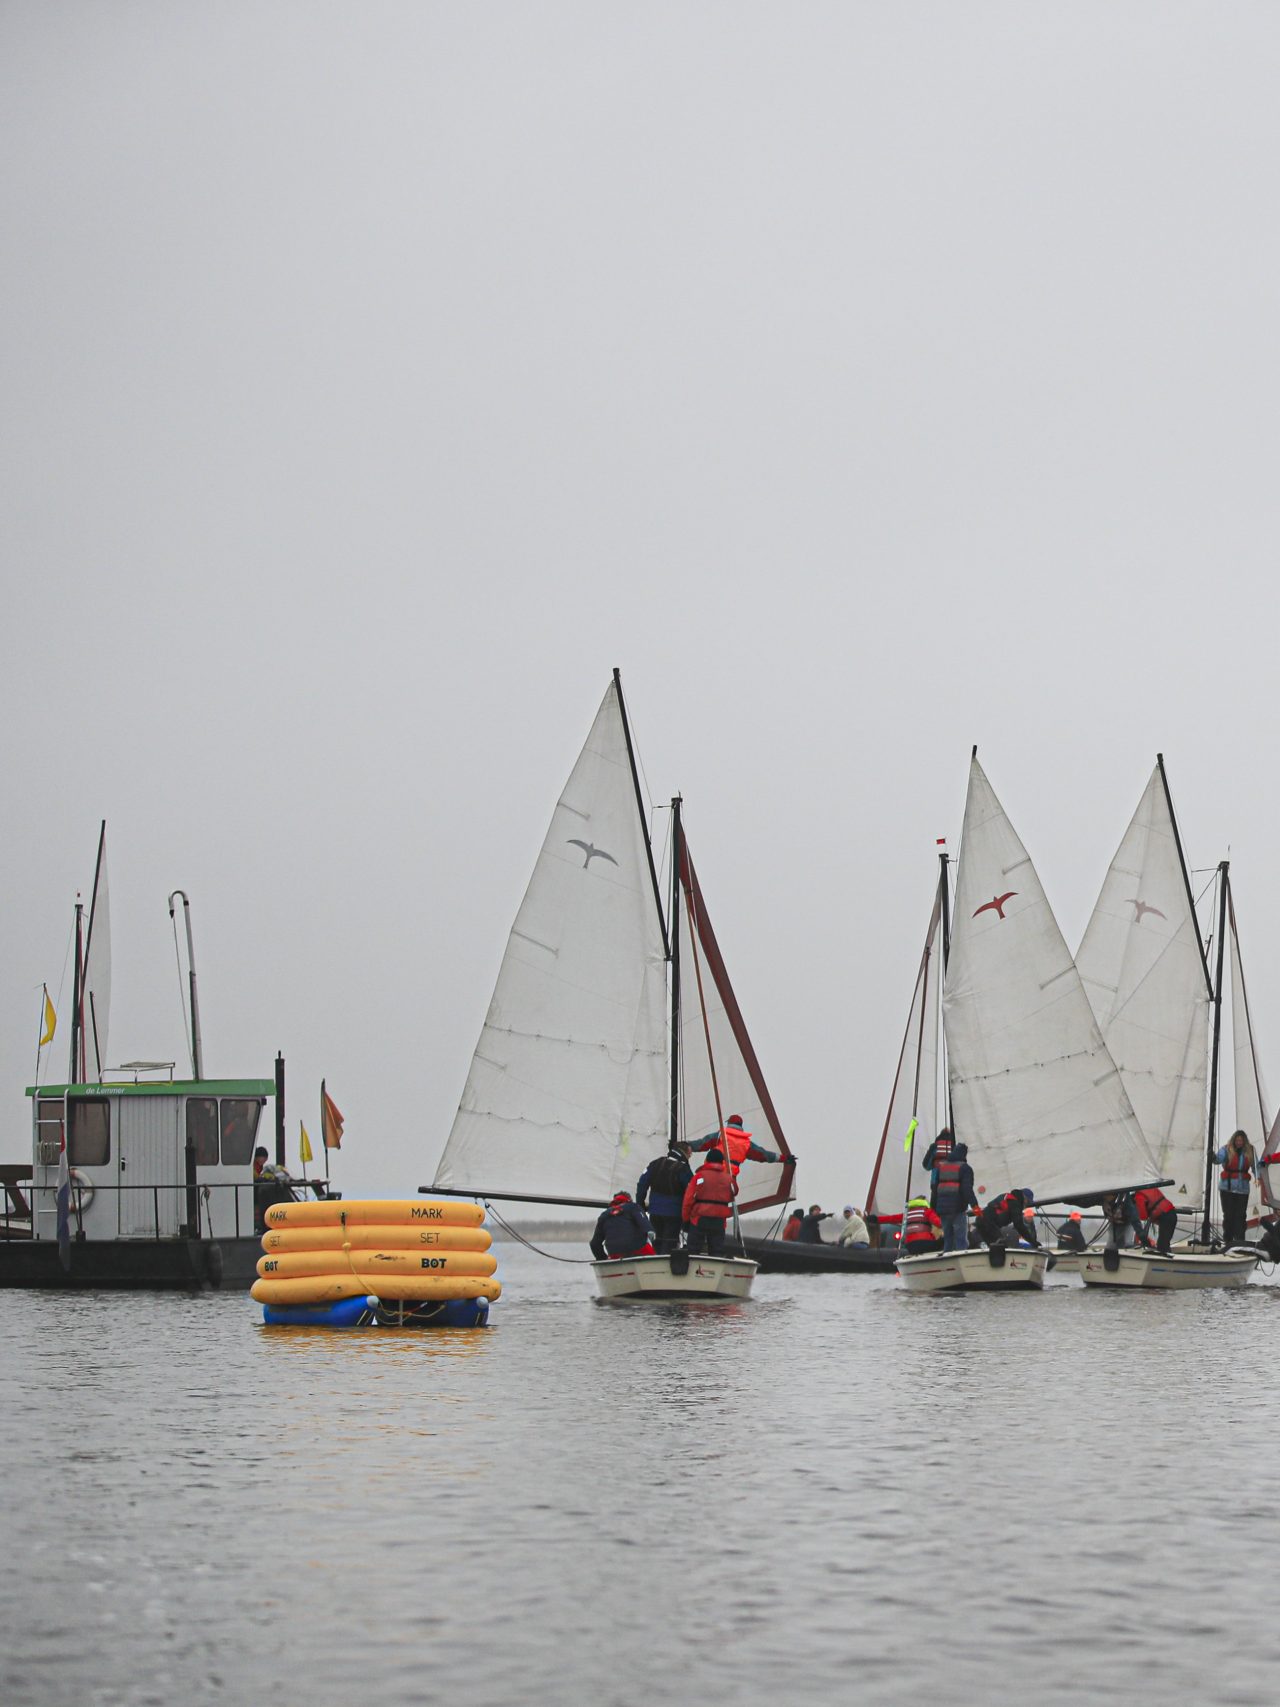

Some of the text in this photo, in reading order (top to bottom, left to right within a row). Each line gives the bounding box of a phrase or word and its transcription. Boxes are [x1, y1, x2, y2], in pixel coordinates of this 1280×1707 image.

[269, 1211, 287, 1221] MARK
[411, 1208, 443, 1219] MARK
[270, 1235, 281, 1247] SET
[420, 1232, 440, 1244] SET
[264, 1260, 279, 1272] BOT
[421, 1257, 447, 1269] BOT
